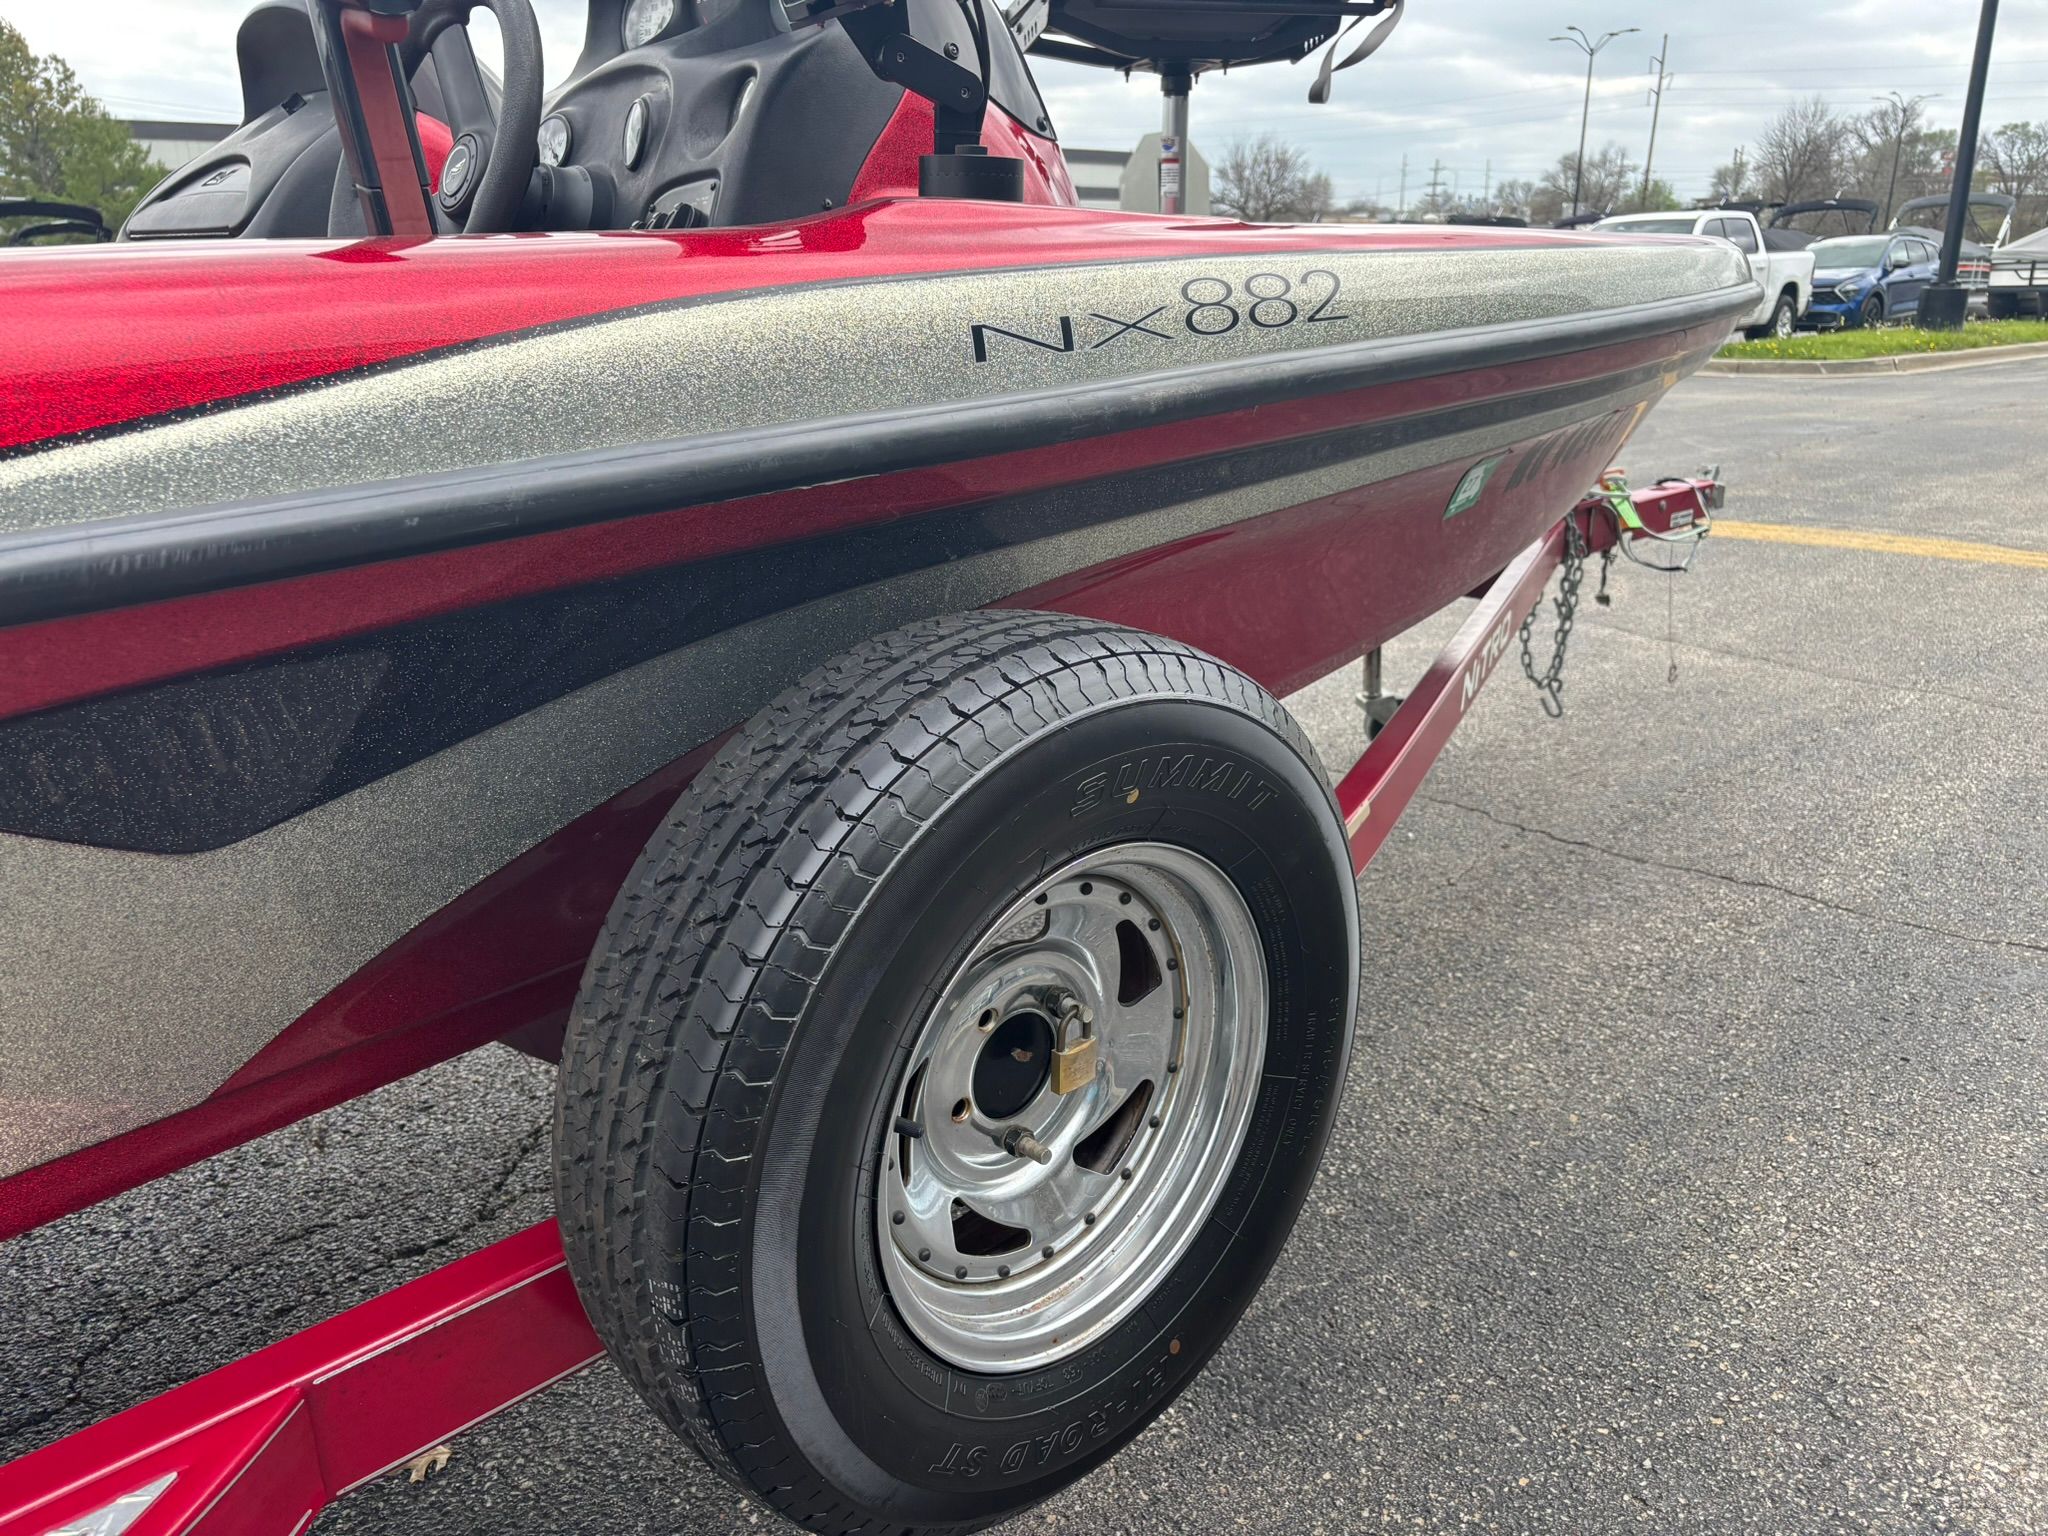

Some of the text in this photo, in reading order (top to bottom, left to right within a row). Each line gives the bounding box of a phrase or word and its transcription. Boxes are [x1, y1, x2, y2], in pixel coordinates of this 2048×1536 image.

[1459, 608, 1513, 714] NITRO
[1070, 754, 1280, 818] SUMMIT
[928, 1440, 992, 1479] ST
